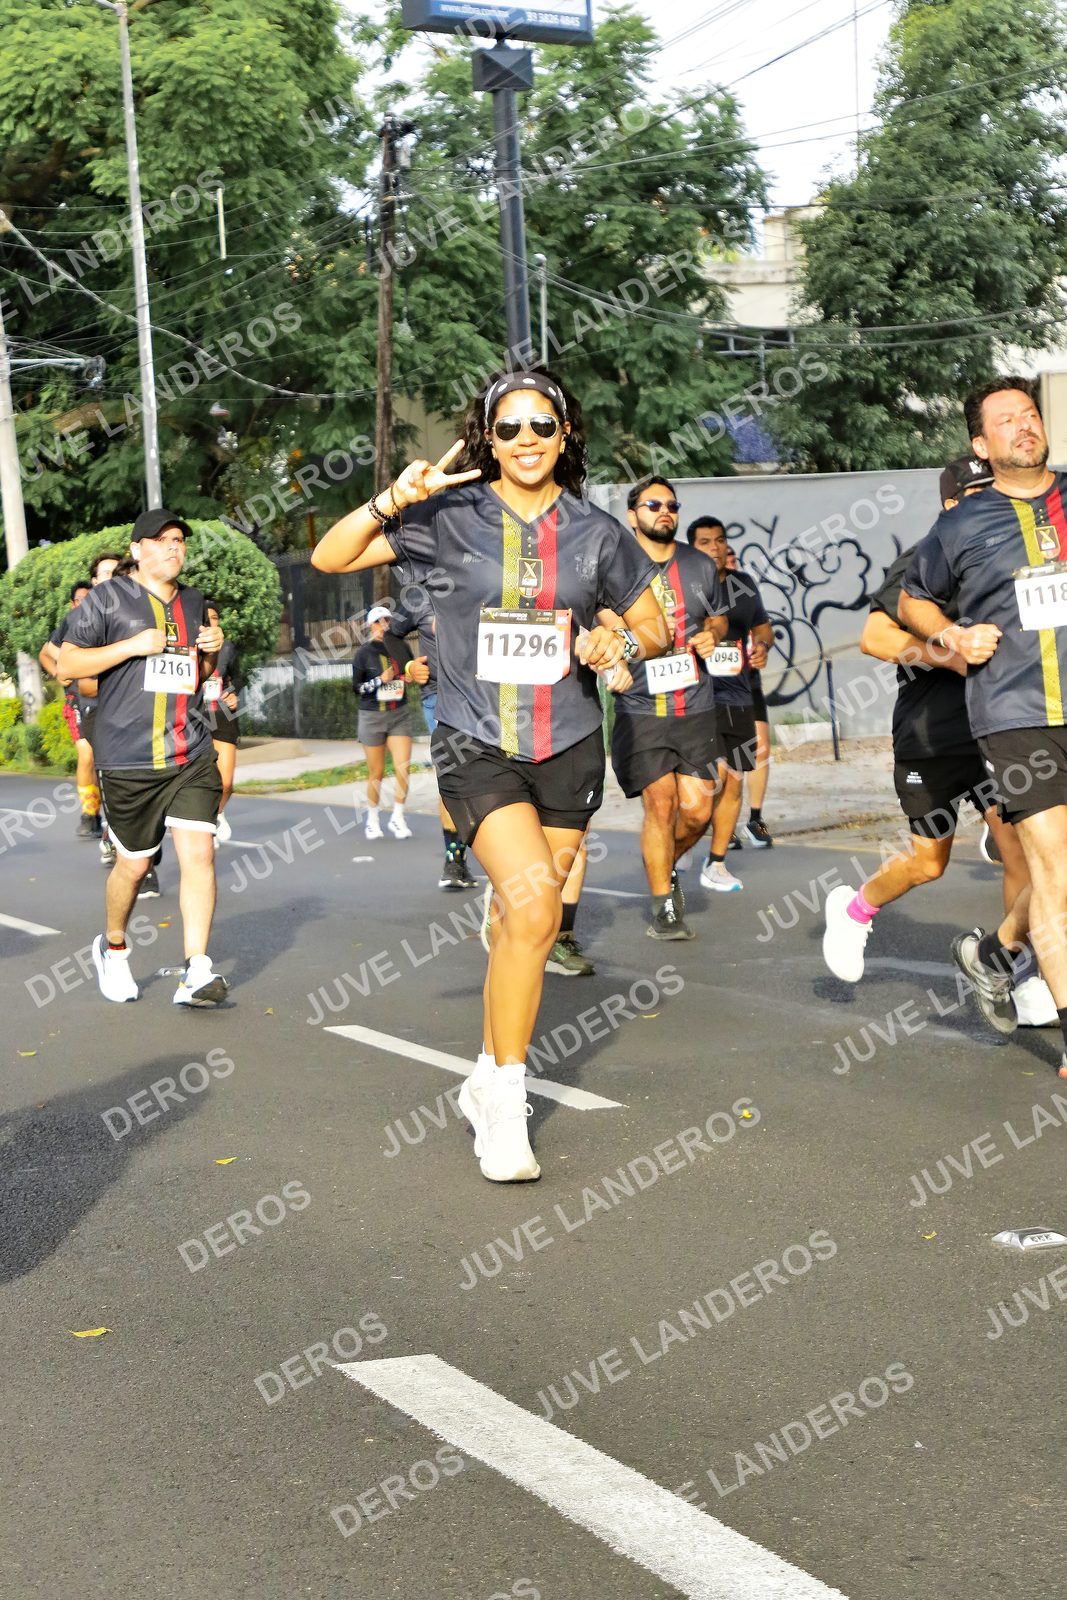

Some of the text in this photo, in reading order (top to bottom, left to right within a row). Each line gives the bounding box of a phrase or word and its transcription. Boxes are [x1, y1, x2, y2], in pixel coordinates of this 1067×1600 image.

[484, 633, 558, 658] 11296
[151, 658, 190, 676] 12161
[651, 660, 690, 678] 12125
